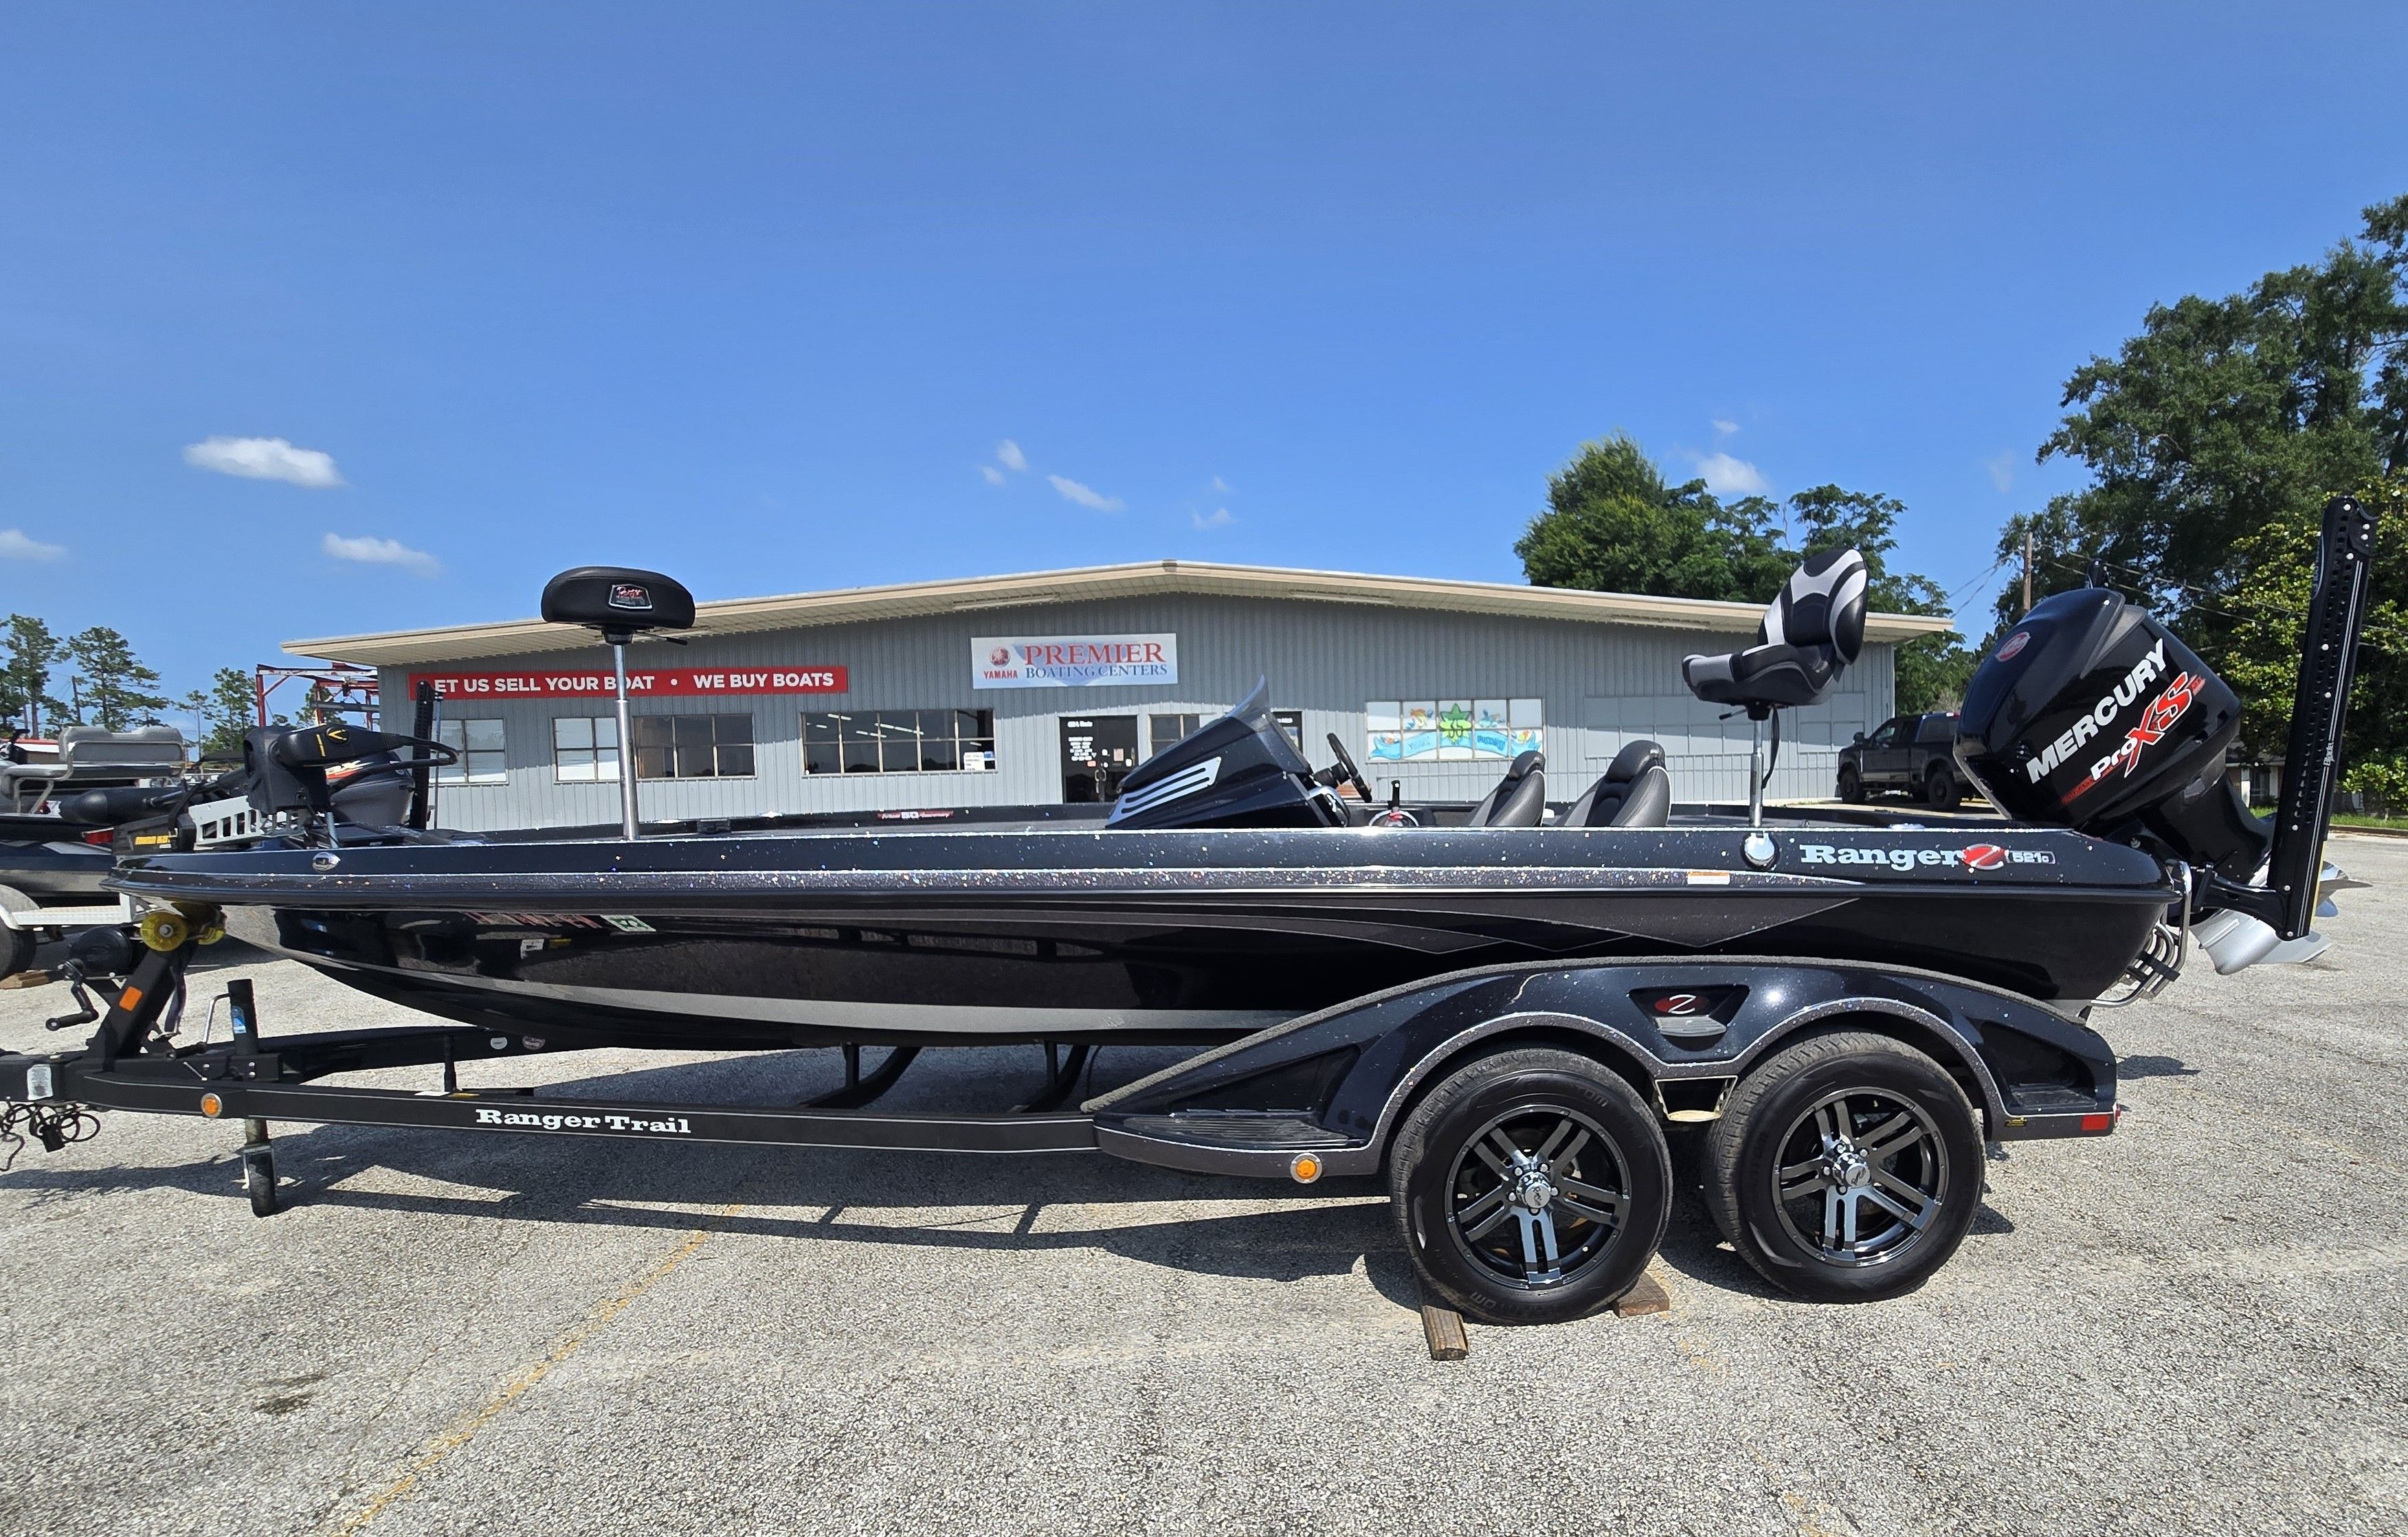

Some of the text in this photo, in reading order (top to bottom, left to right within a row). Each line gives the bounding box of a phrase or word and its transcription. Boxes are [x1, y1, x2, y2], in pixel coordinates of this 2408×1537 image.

[1025, 643, 1166, 665] PREMIER
[983, 670, 1018, 680] YAMAHA
[1026, 664, 1168, 678] BOATING CENTERS
[434, 679, 458, 693] ET
[464, 678, 489, 692] US
[495, 677, 541, 691] SELL
[545, 677, 599, 691] YOUR
[693, 675, 725, 688] WE
[730, 673, 768, 688] BUY
[773, 673, 834, 687] BOATS
[2027, 638, 2166, 784] MERCURY
[1799, 844, 1967, 871] Ranger
[476, 1108, 691, 1134] Ranger Trail
